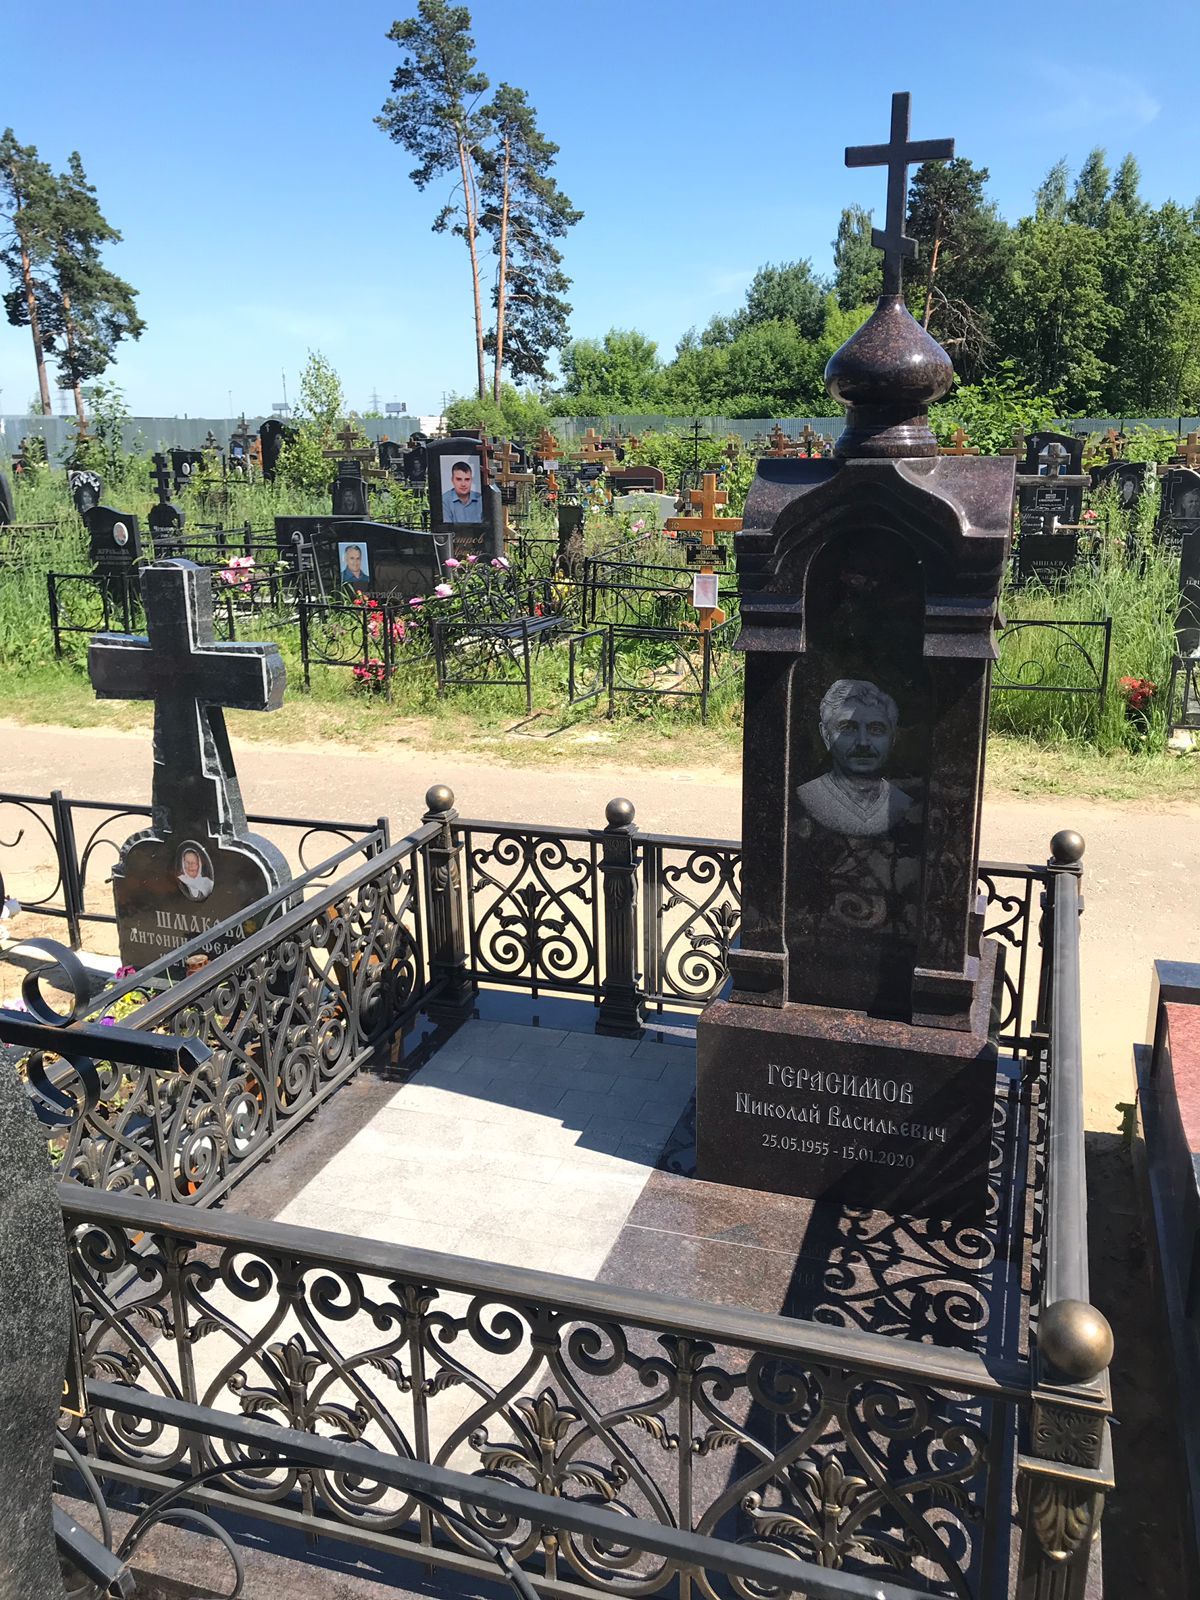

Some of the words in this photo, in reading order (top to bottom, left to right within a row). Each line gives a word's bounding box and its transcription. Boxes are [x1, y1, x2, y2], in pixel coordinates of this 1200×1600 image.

[767, 1063, 913, 1104] ГЕРАСИМОВ
[735, 1091, 821, 1124] Николай
[827, 1105, 948, 1143] Васильевич
[761, 1133, 830, 1156] 25.05.1955
[841, 1146, 915, 1169] 15.01.2020
